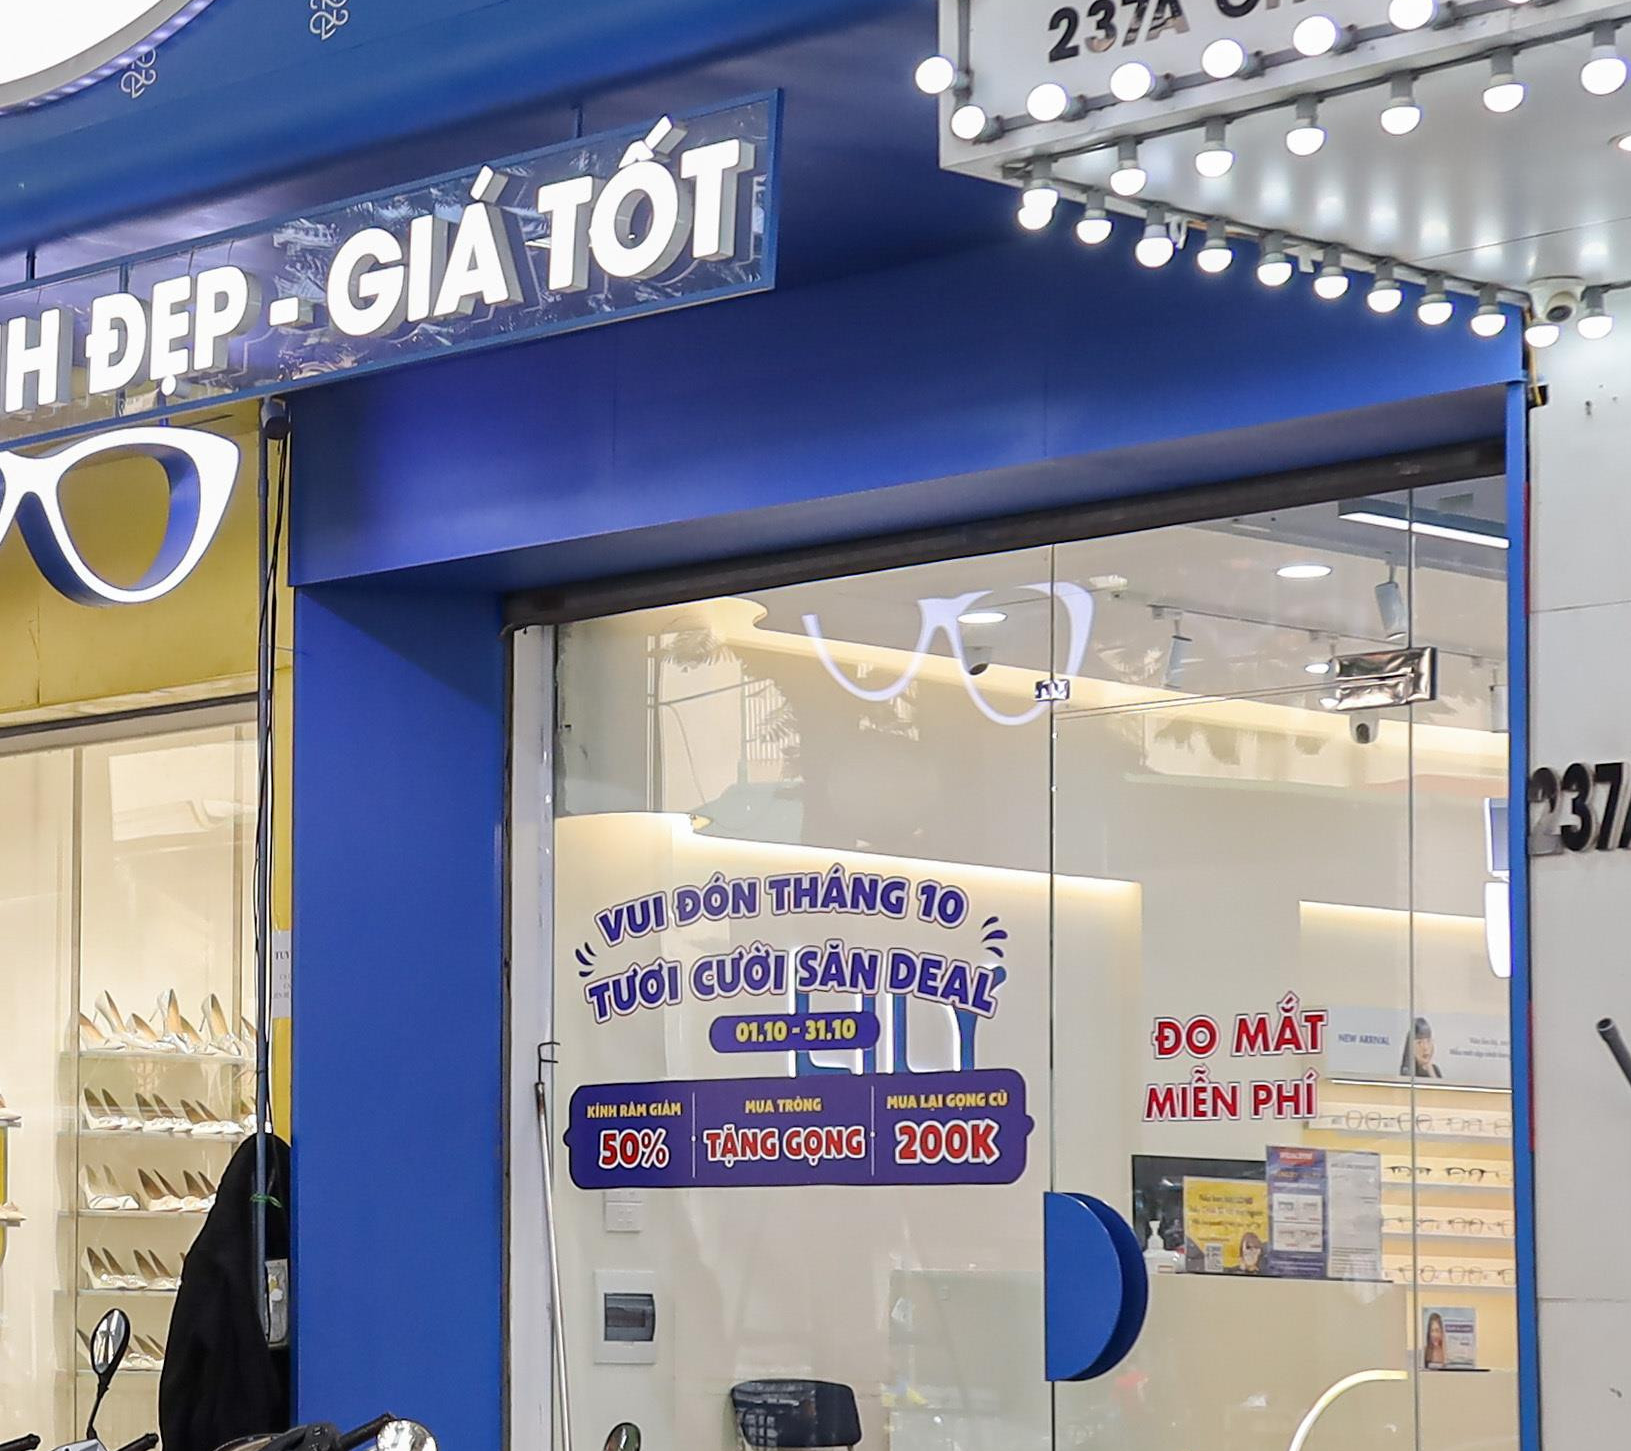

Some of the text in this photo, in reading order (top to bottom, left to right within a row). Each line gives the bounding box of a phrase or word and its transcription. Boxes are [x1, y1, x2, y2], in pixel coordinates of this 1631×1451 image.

[85, 264, 262, 397] ĐẸP
[329, 165, 518, 337] GIÁ
[536, 115, 748, 292] TỐT
[597, 864, 968, 946] VUI ĐÓN THÁNG 10
[586, 962, 681, 1024] TƯƠI
[691, 942, 788, 1000] CƯỜI
[797, 939, 879, 994] SĂN
[887, 950, 1002, 1018] DEAL
[736, 1018, 857, 1042] 01.10 31.10
[1153, 990, 1328, 1059] ĐO MẮT
[586, 1101, 617, 1118] KÍNH
[745, 1099, 774, 1114] MUA
[887, 1092, 986, 1113] MUA LẠI GỌNG
[1142, 1065, 1319, 1123] MIỄN PHÍ
[599, 1128, 670, 1170] 50%
[703, 1124, 865, 1167] TẶNG GỌNG
[896, 1119, 999, 1164] 200K
